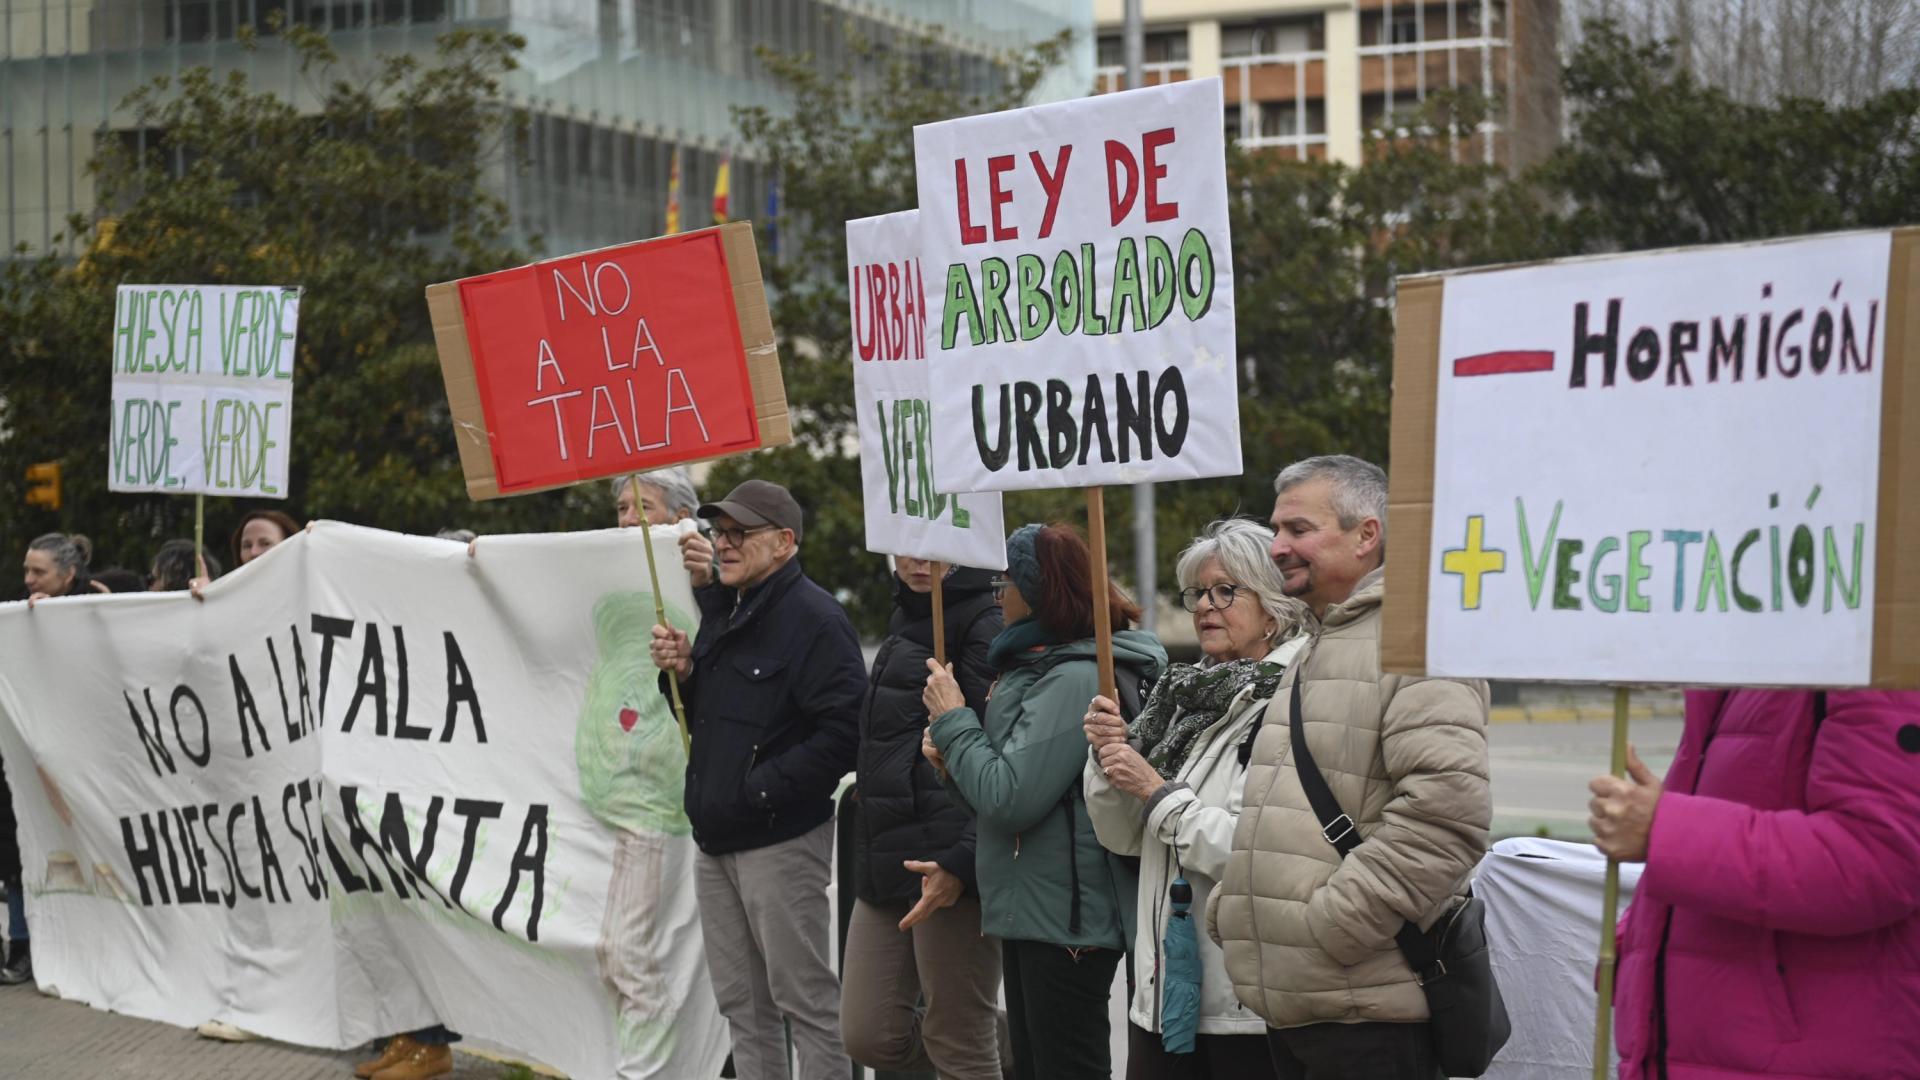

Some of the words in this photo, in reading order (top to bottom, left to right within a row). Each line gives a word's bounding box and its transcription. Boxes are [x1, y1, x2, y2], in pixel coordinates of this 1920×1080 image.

[955, 144, 1073, 245] LEY
[1104, 127, 1179, 227] DE
[114, 289, 203, 374] HUESCA
[219, 290, 298, 379] VERDE
[553, 261, 631, 321] NO
[941, 227, 1215, 350] ARBOLADO
[536, 339, 566, 391] A
[600, 317, 665, 371] LA
[111, 398, 187, 490] VERDE,
[201, 399, 282, 494] VERDE
[527, 367, 711, 461] TALA
[972, 365, 1190, 472] URBANO
[123, 685, 211, 777] NO
[229, 653, 271, 758] A
[266, 624, 315, 743] LA
[311, 613, 488, 744] TALA
[120, 795, 291, 910] HUESCA
